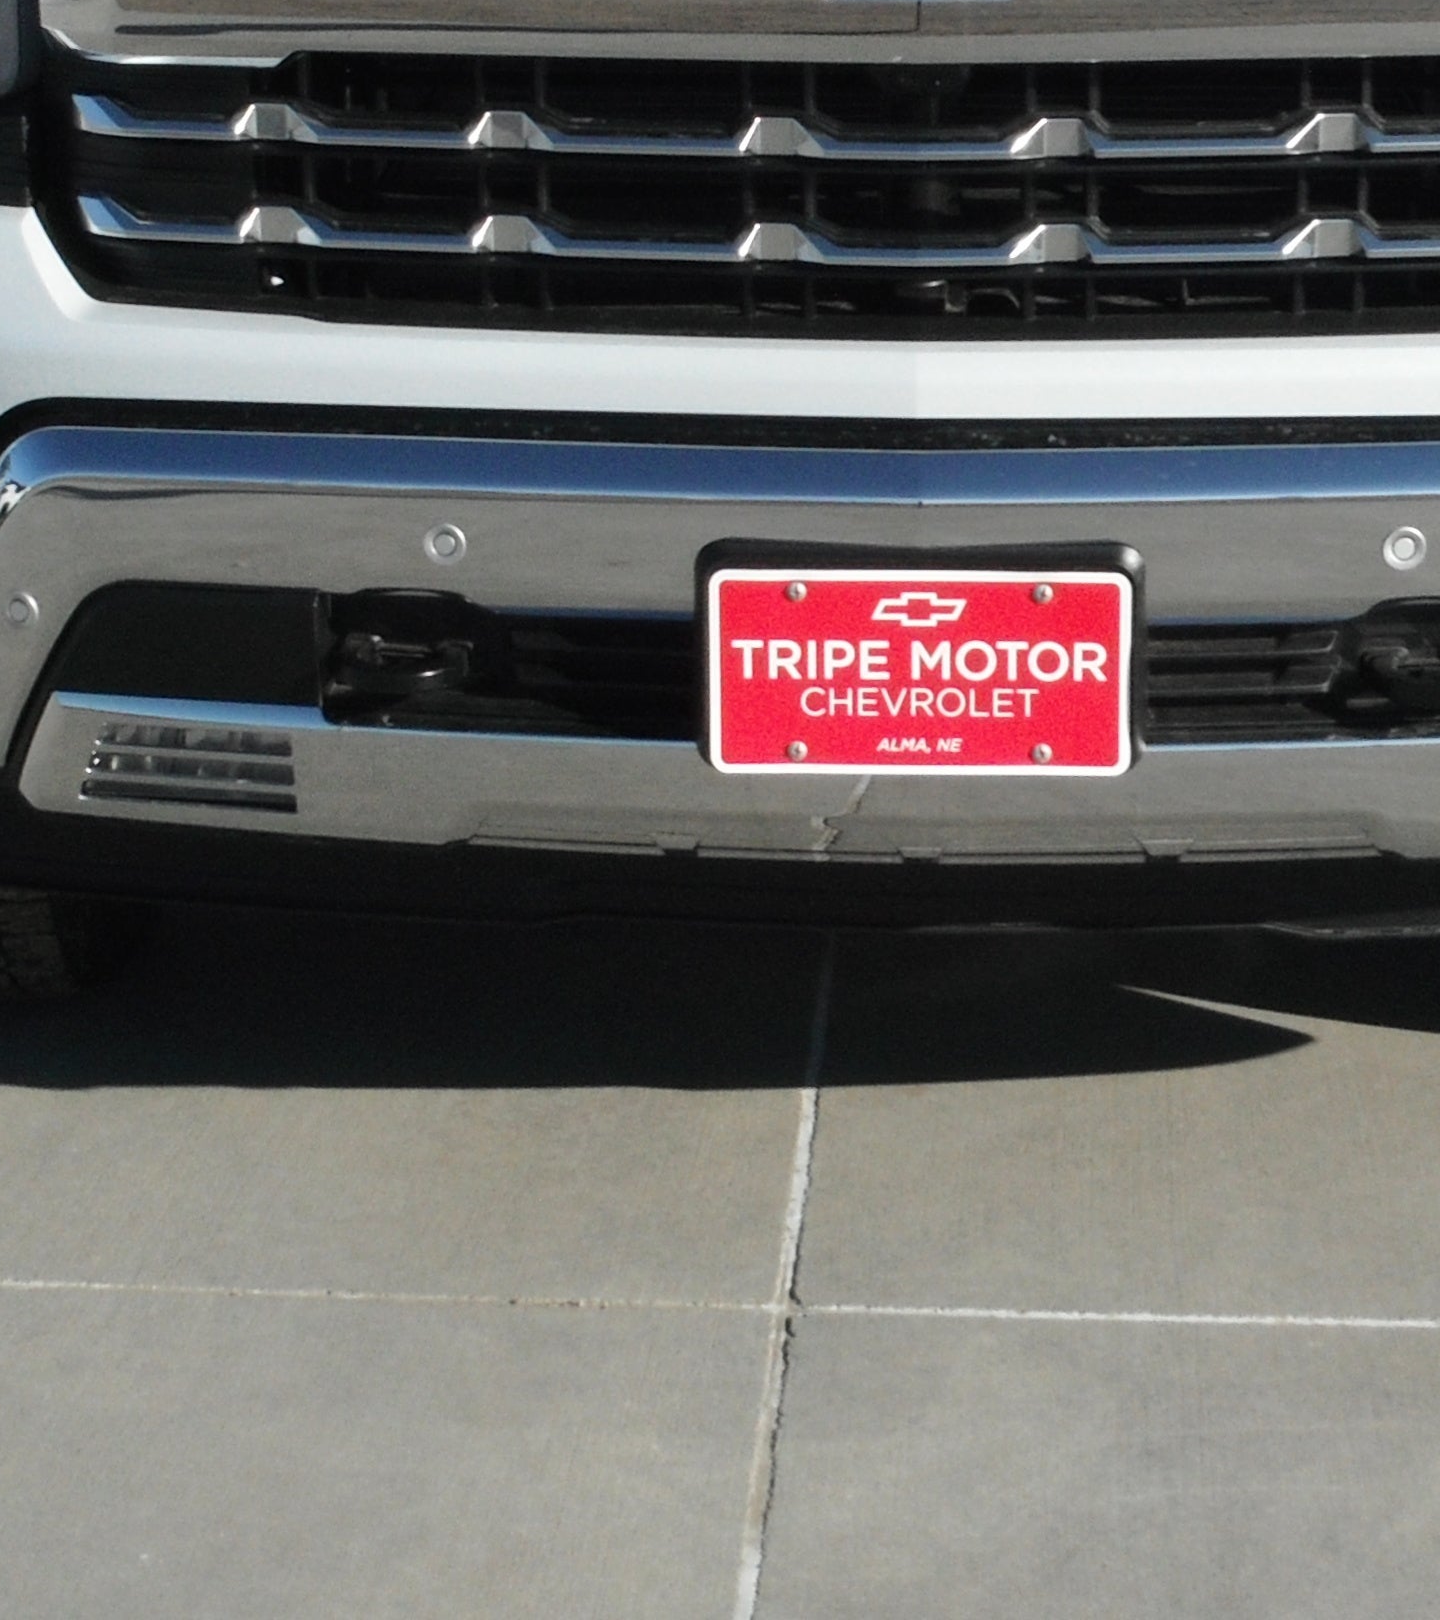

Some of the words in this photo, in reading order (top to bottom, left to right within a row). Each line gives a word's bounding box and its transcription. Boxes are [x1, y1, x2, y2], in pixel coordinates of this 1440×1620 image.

[730, 638, 891, 681] TRIPE
[910, 639, 1109, 683] MOTOR
[799, 686, 1040, 718] CHEVROLET
[876, 737, 932, 754] ALMA,
[935, 737, 964, 753] NE
